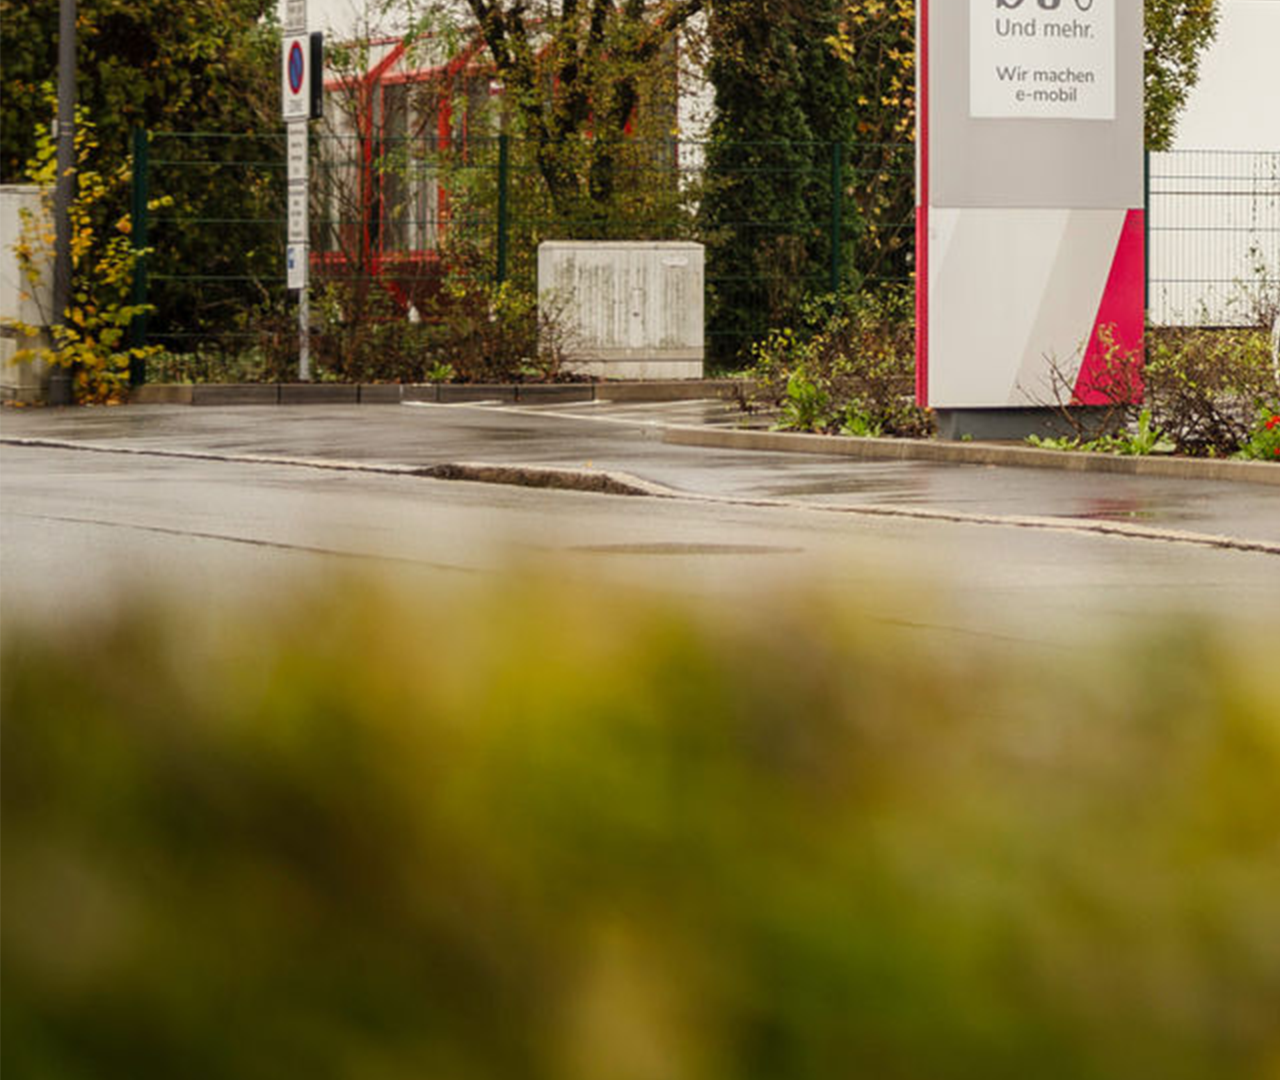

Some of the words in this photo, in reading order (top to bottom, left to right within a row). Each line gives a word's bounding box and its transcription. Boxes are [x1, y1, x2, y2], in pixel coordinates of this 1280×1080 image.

[995, 18, 1036, 37] Und
[1043, 19, 1094, 39] mehr.
[996, 65, 1028, 81] Wir
[1033, 67, 1095, 83] machen
[1015, 87, 1078, 102] e-mobil
